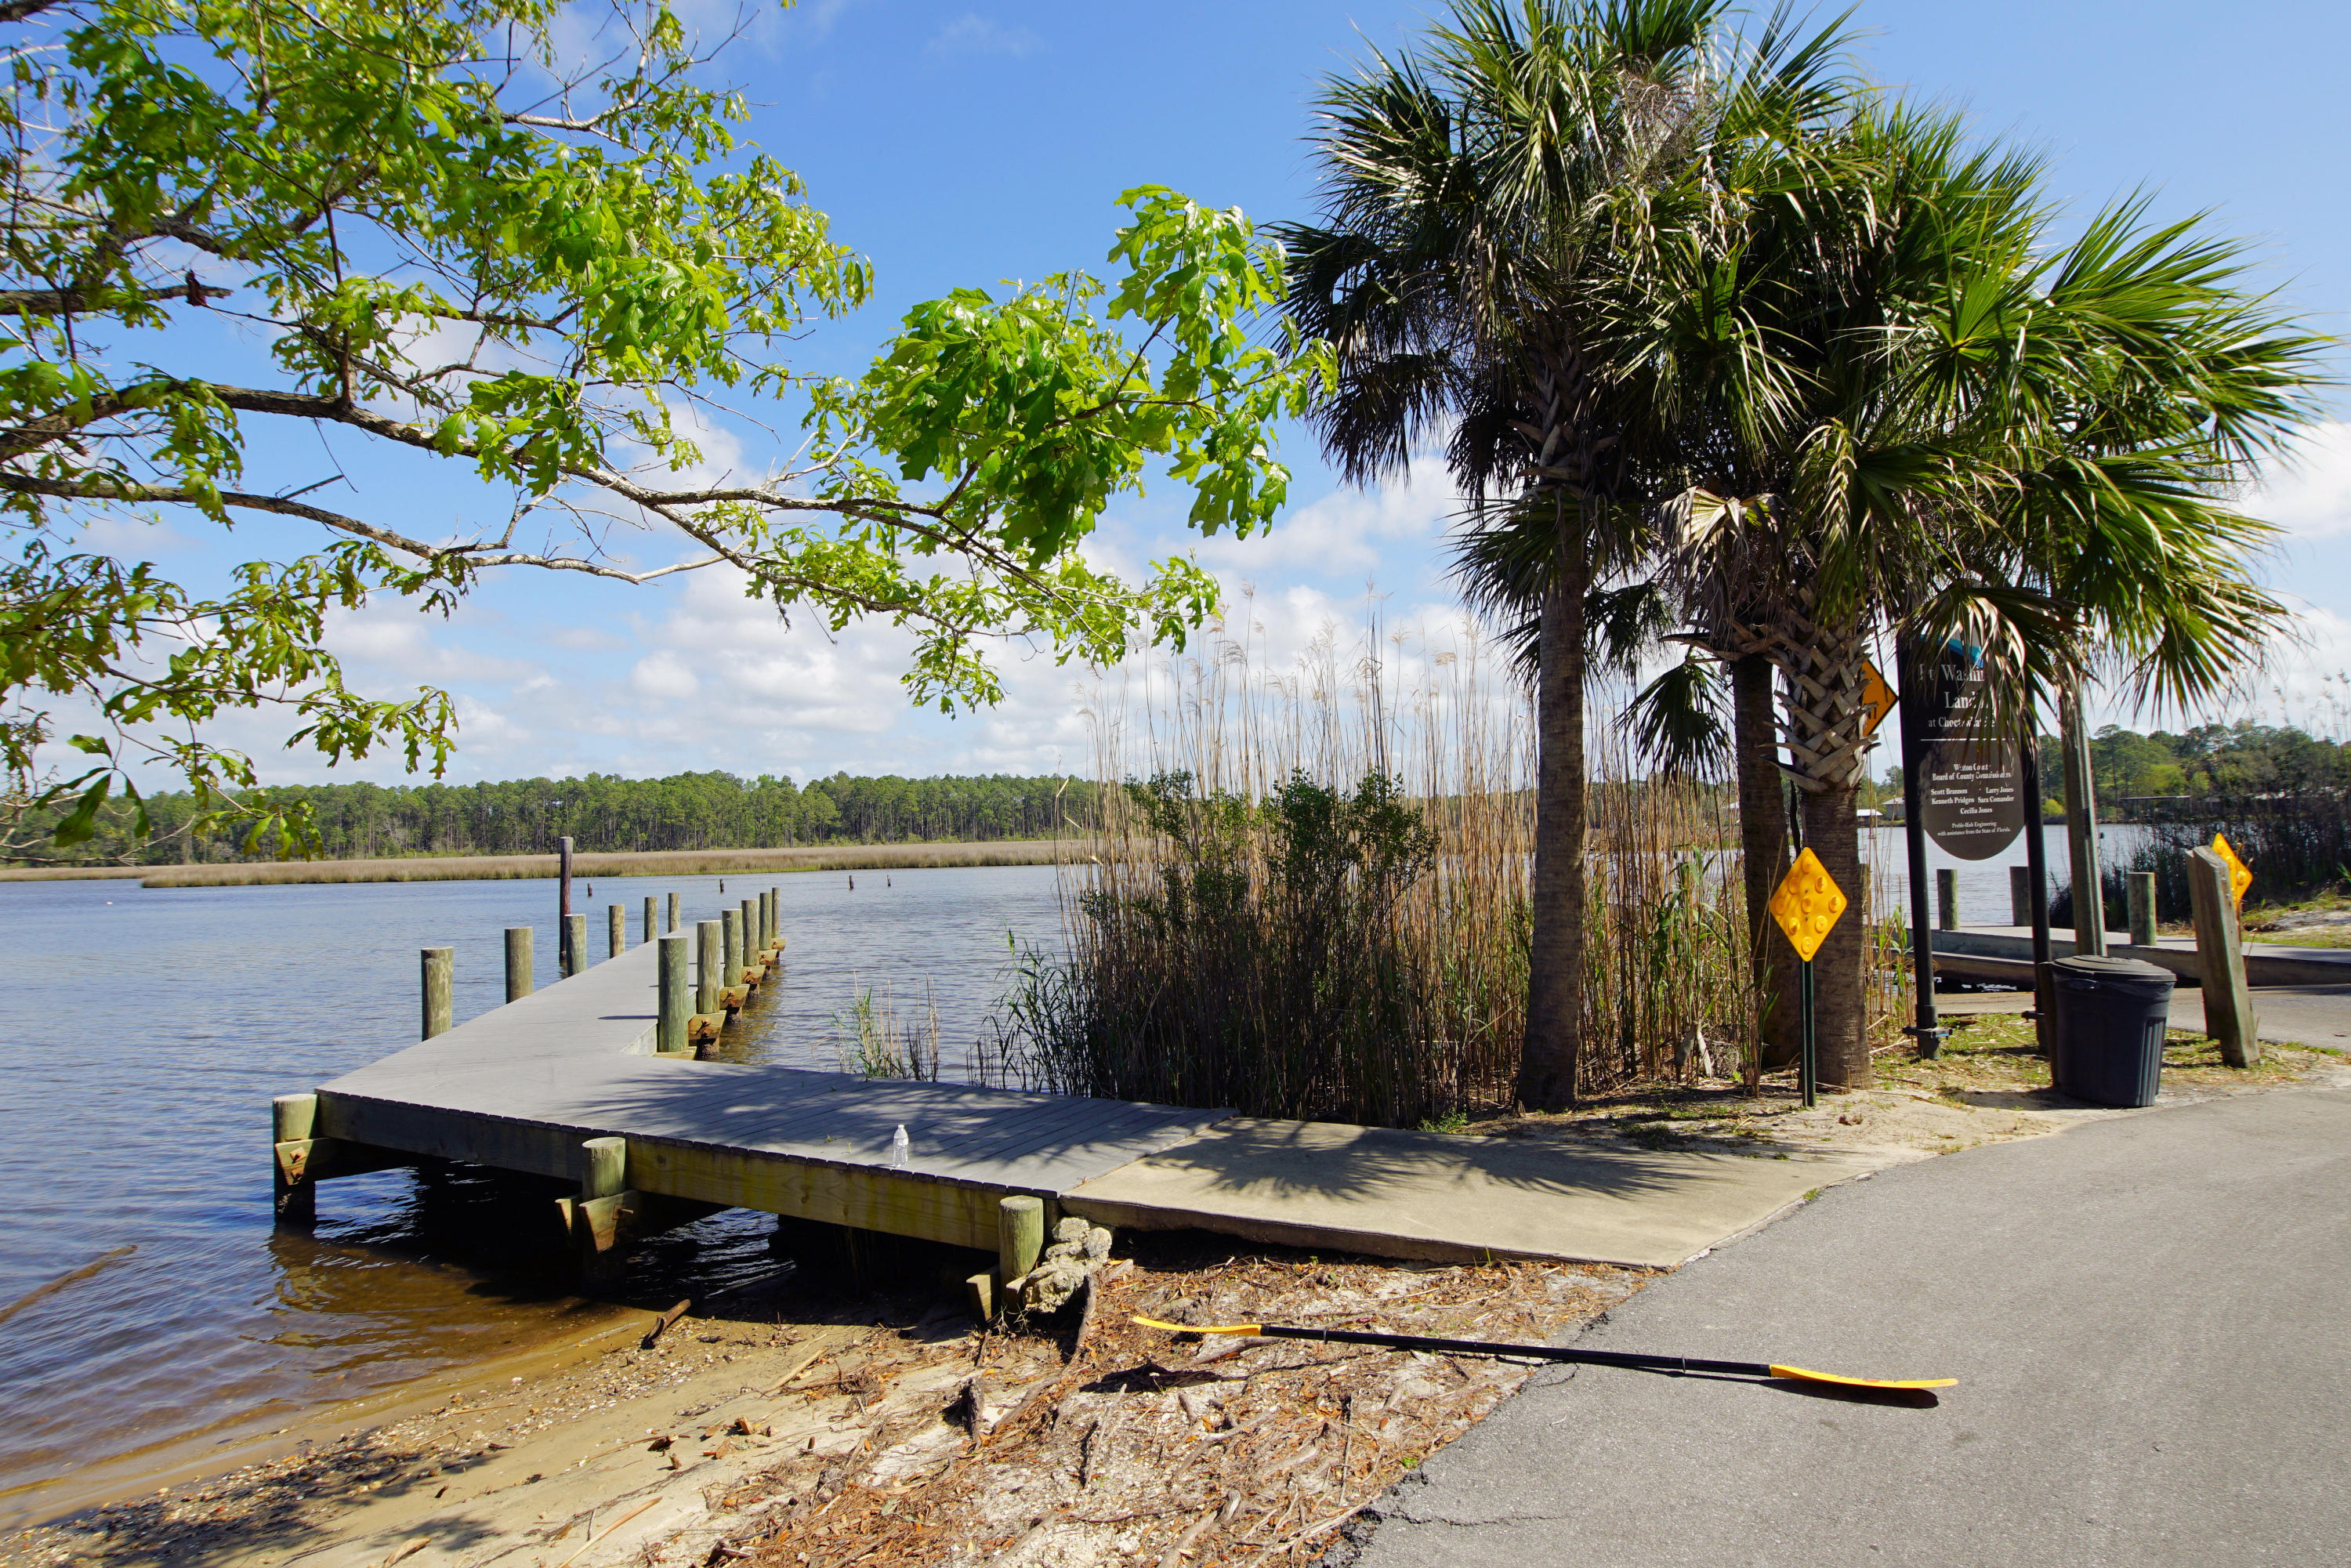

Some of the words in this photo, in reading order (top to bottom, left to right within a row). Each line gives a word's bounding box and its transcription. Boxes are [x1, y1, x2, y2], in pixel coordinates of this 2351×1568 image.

[1928, 719, 1936, 727] at
[1957, 773, 1975, 781] County
[1986, 787, 1999, 795] Larry
